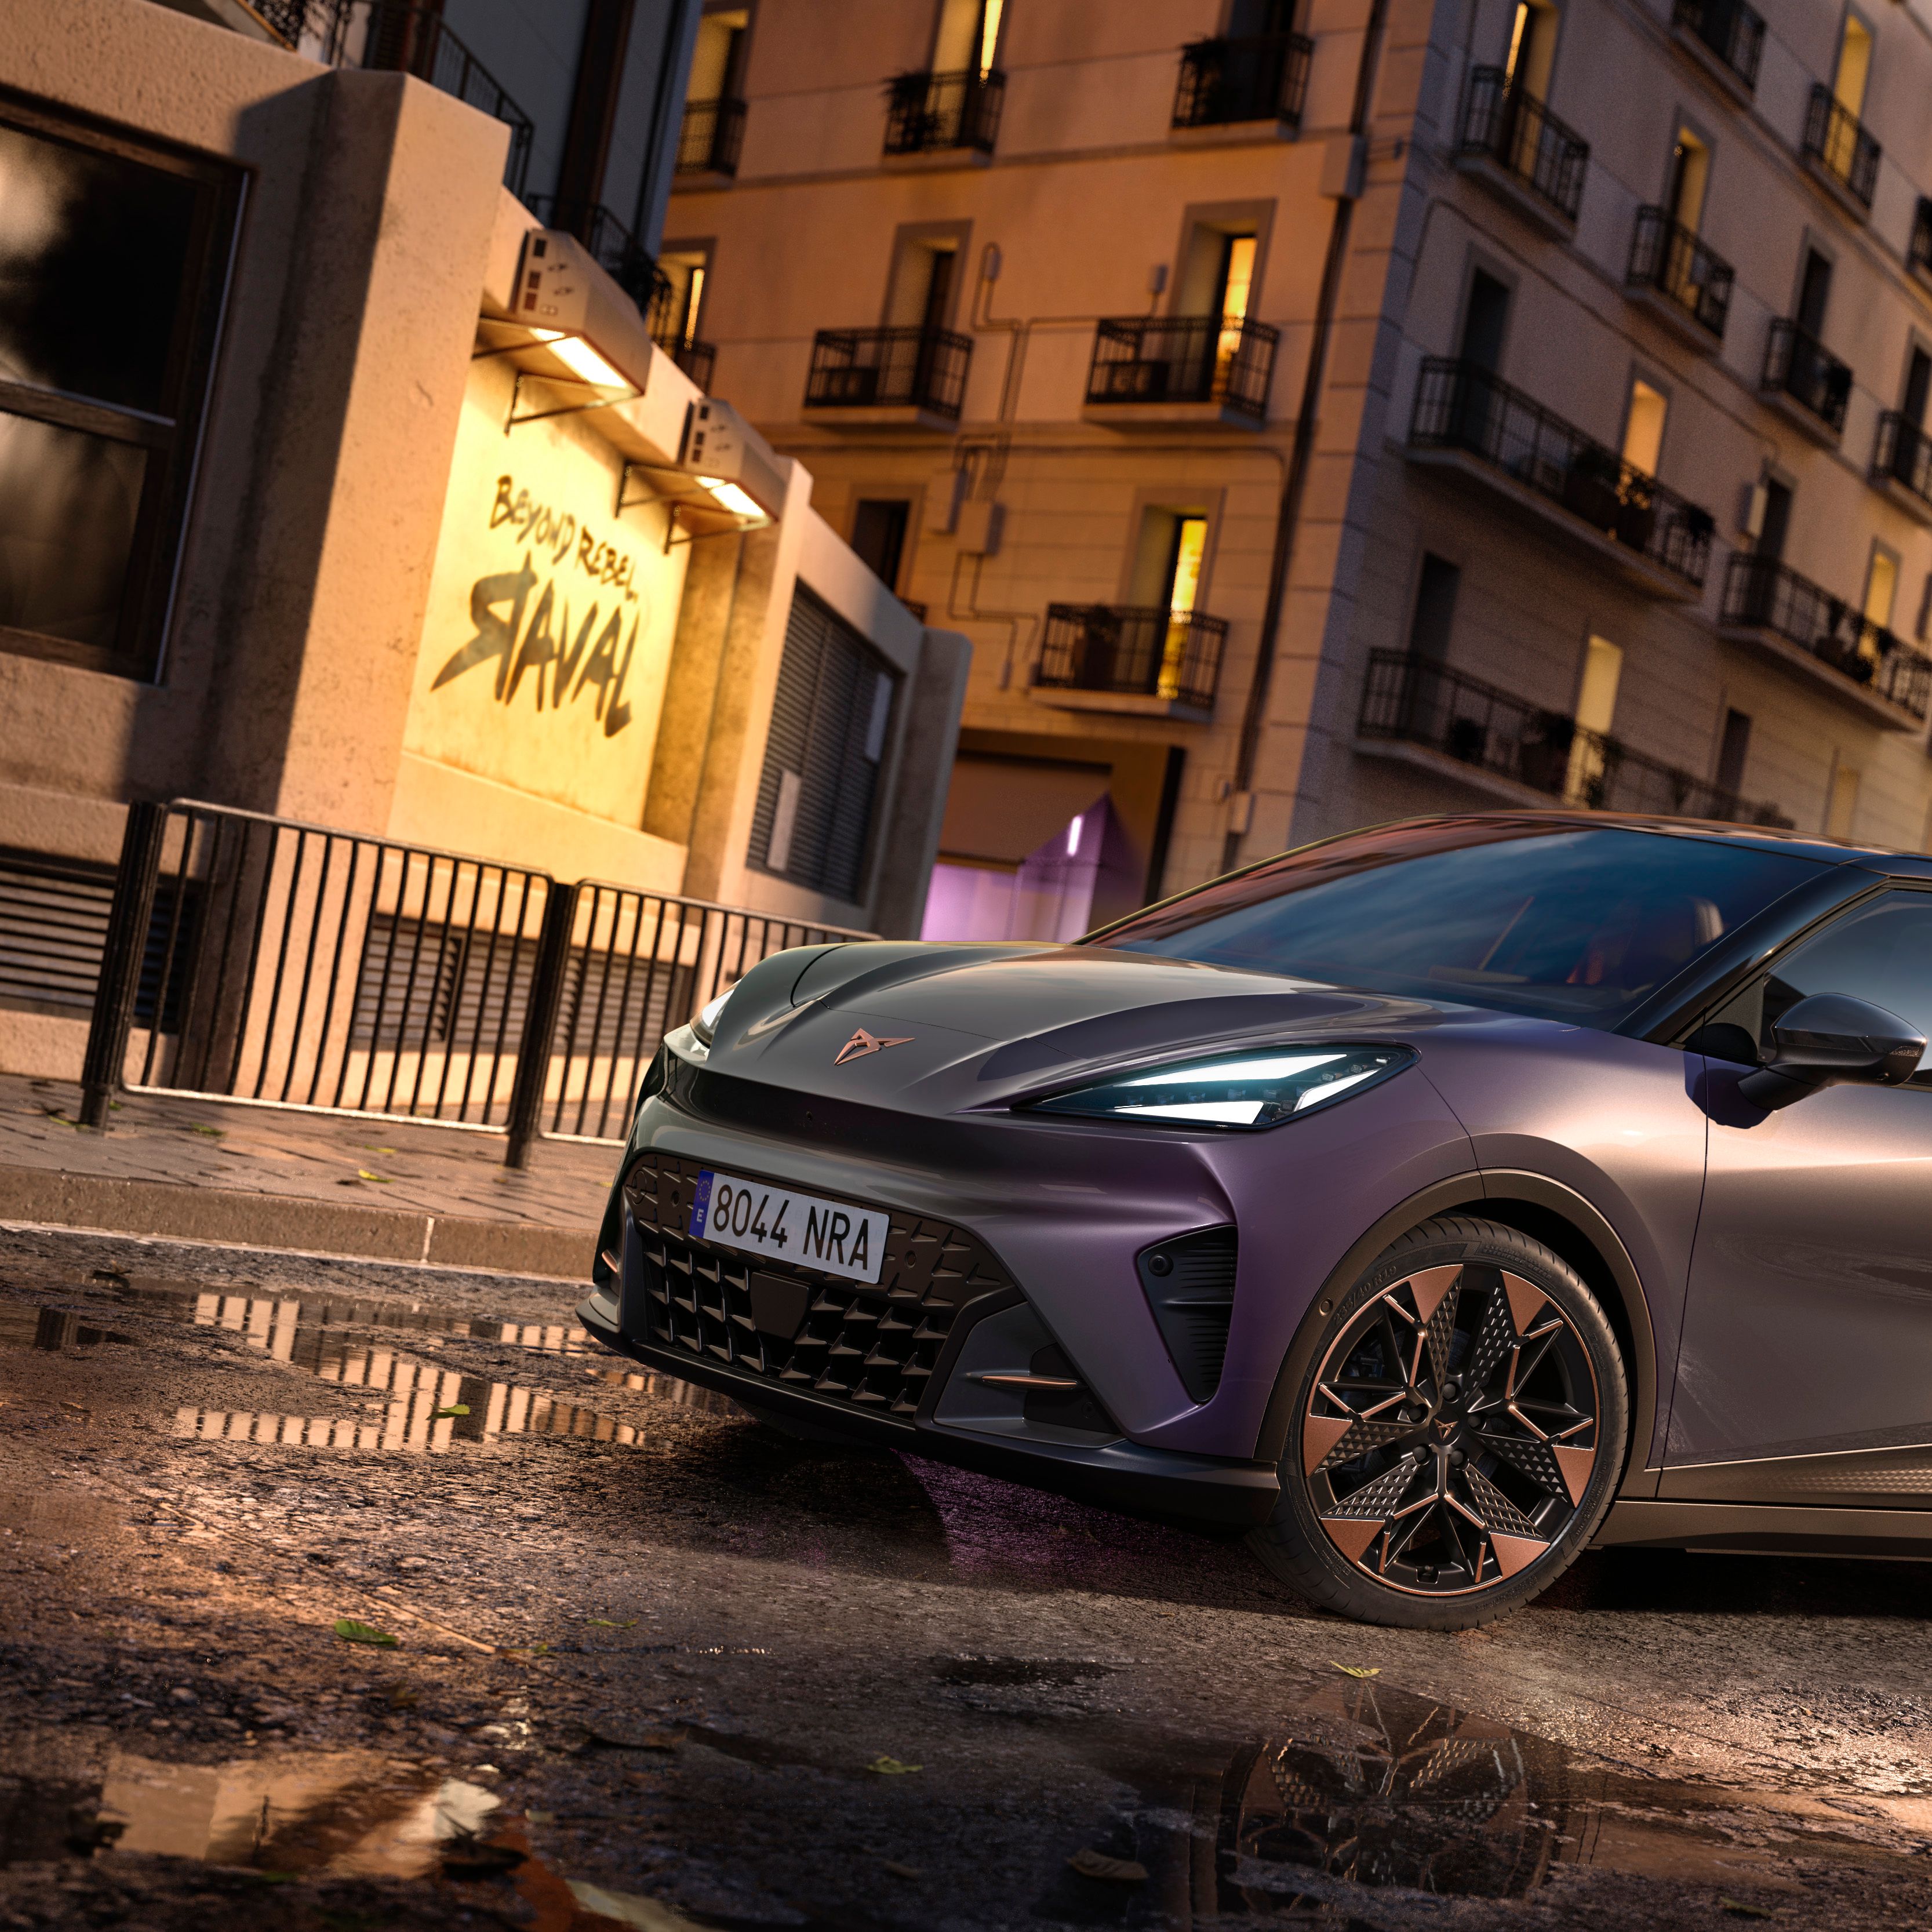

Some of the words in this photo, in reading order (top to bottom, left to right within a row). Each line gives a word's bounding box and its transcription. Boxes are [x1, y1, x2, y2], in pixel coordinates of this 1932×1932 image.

[696, 1209, 704, 1222] E
[713, 1184, 789, 1248] 8044
[803, 1206, 868, 1270] NRA
